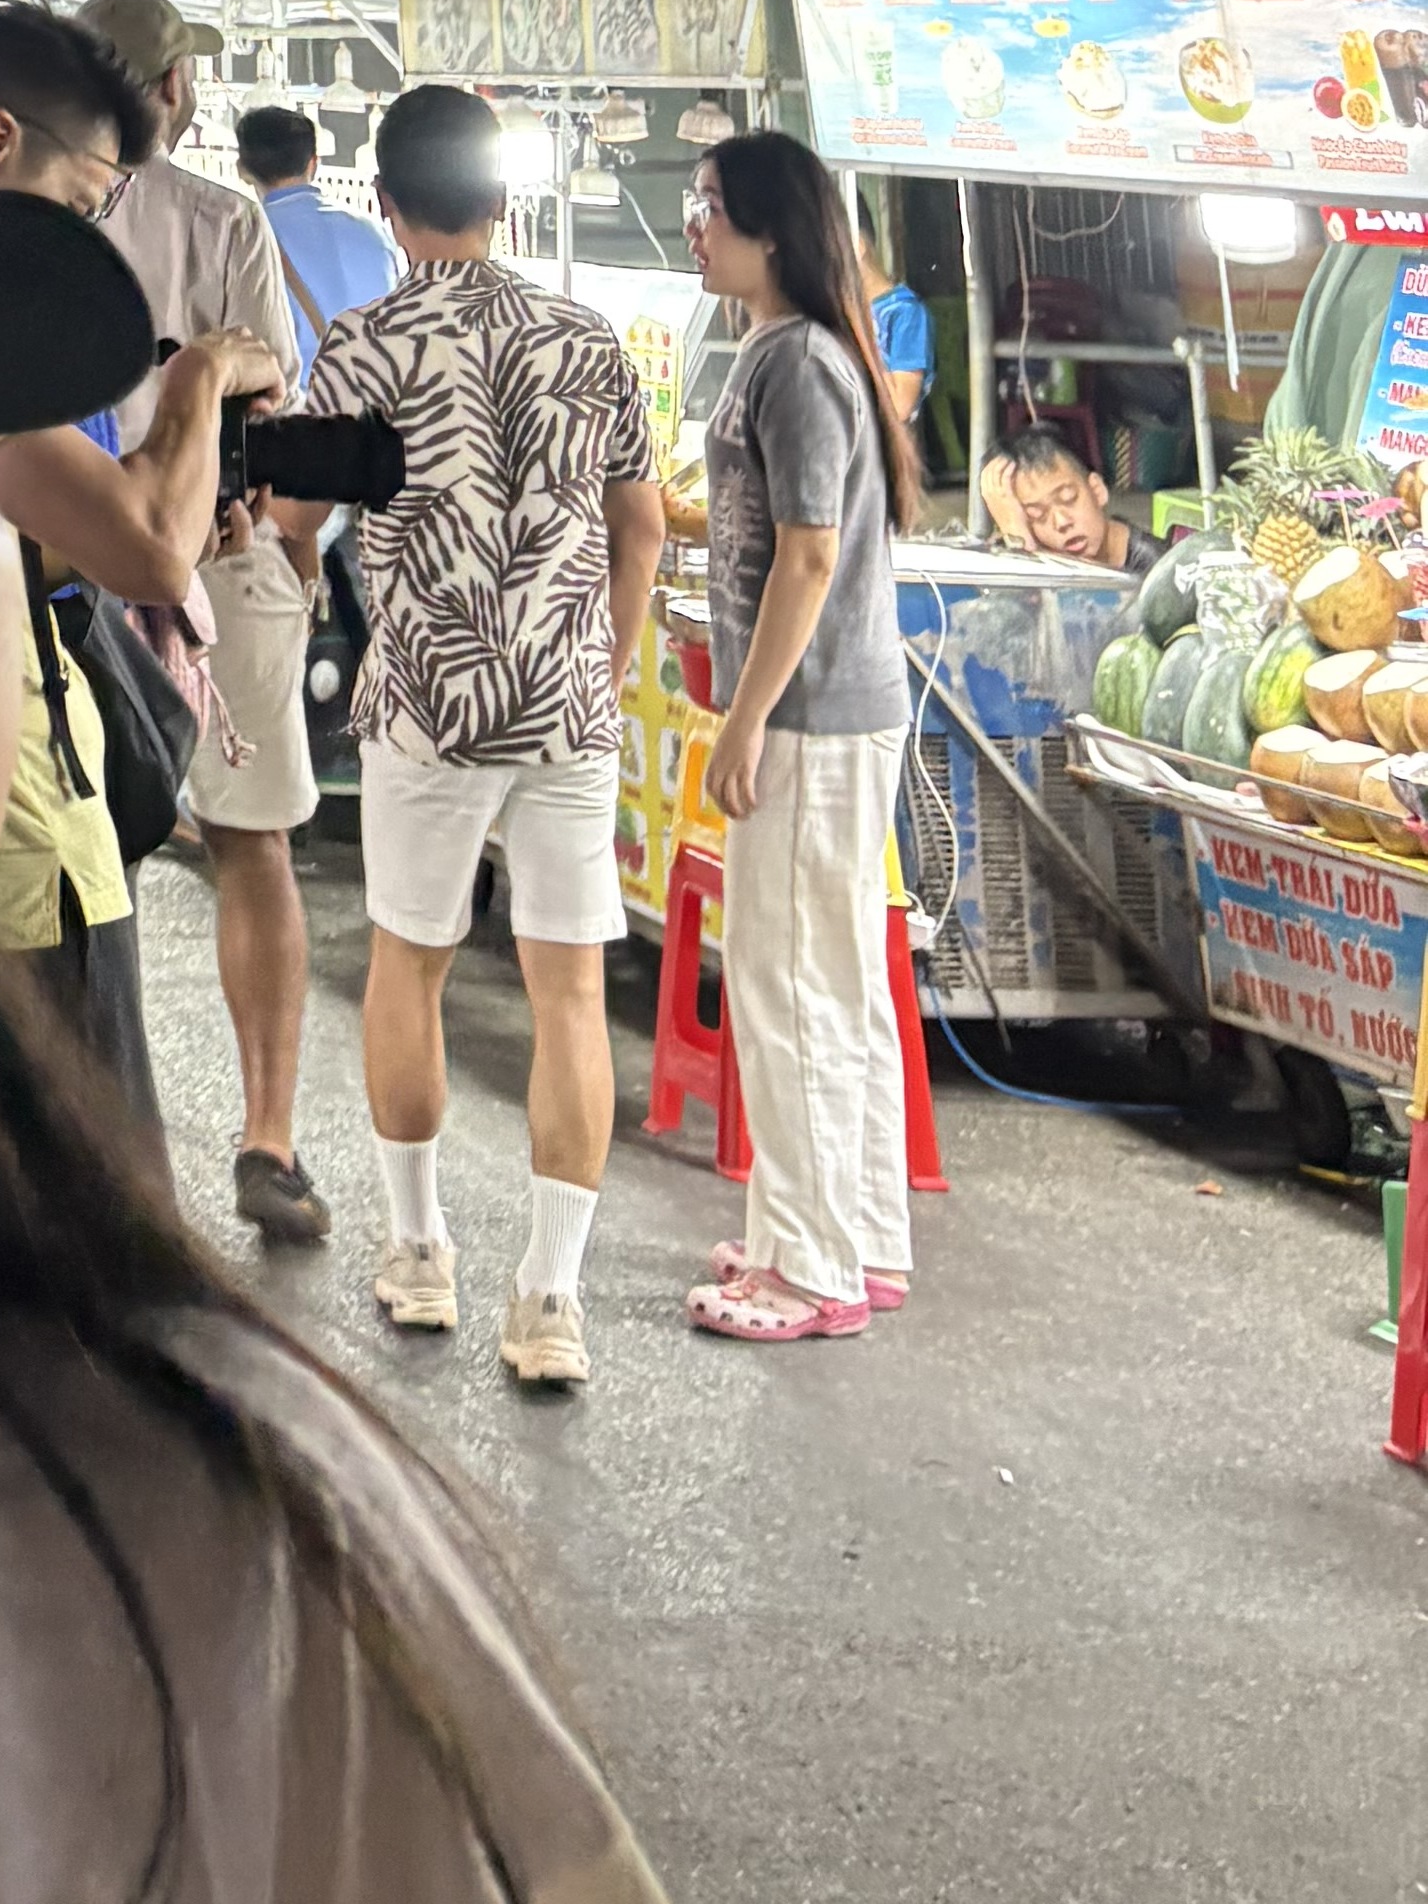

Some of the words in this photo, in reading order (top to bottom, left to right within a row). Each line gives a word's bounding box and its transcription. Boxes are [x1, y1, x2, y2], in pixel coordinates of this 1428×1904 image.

[1211, 835, 1269, 890] KEM
[1270, 854, 1336, 912] TRÁI
[1221, 897, 1280, 954] KEM
